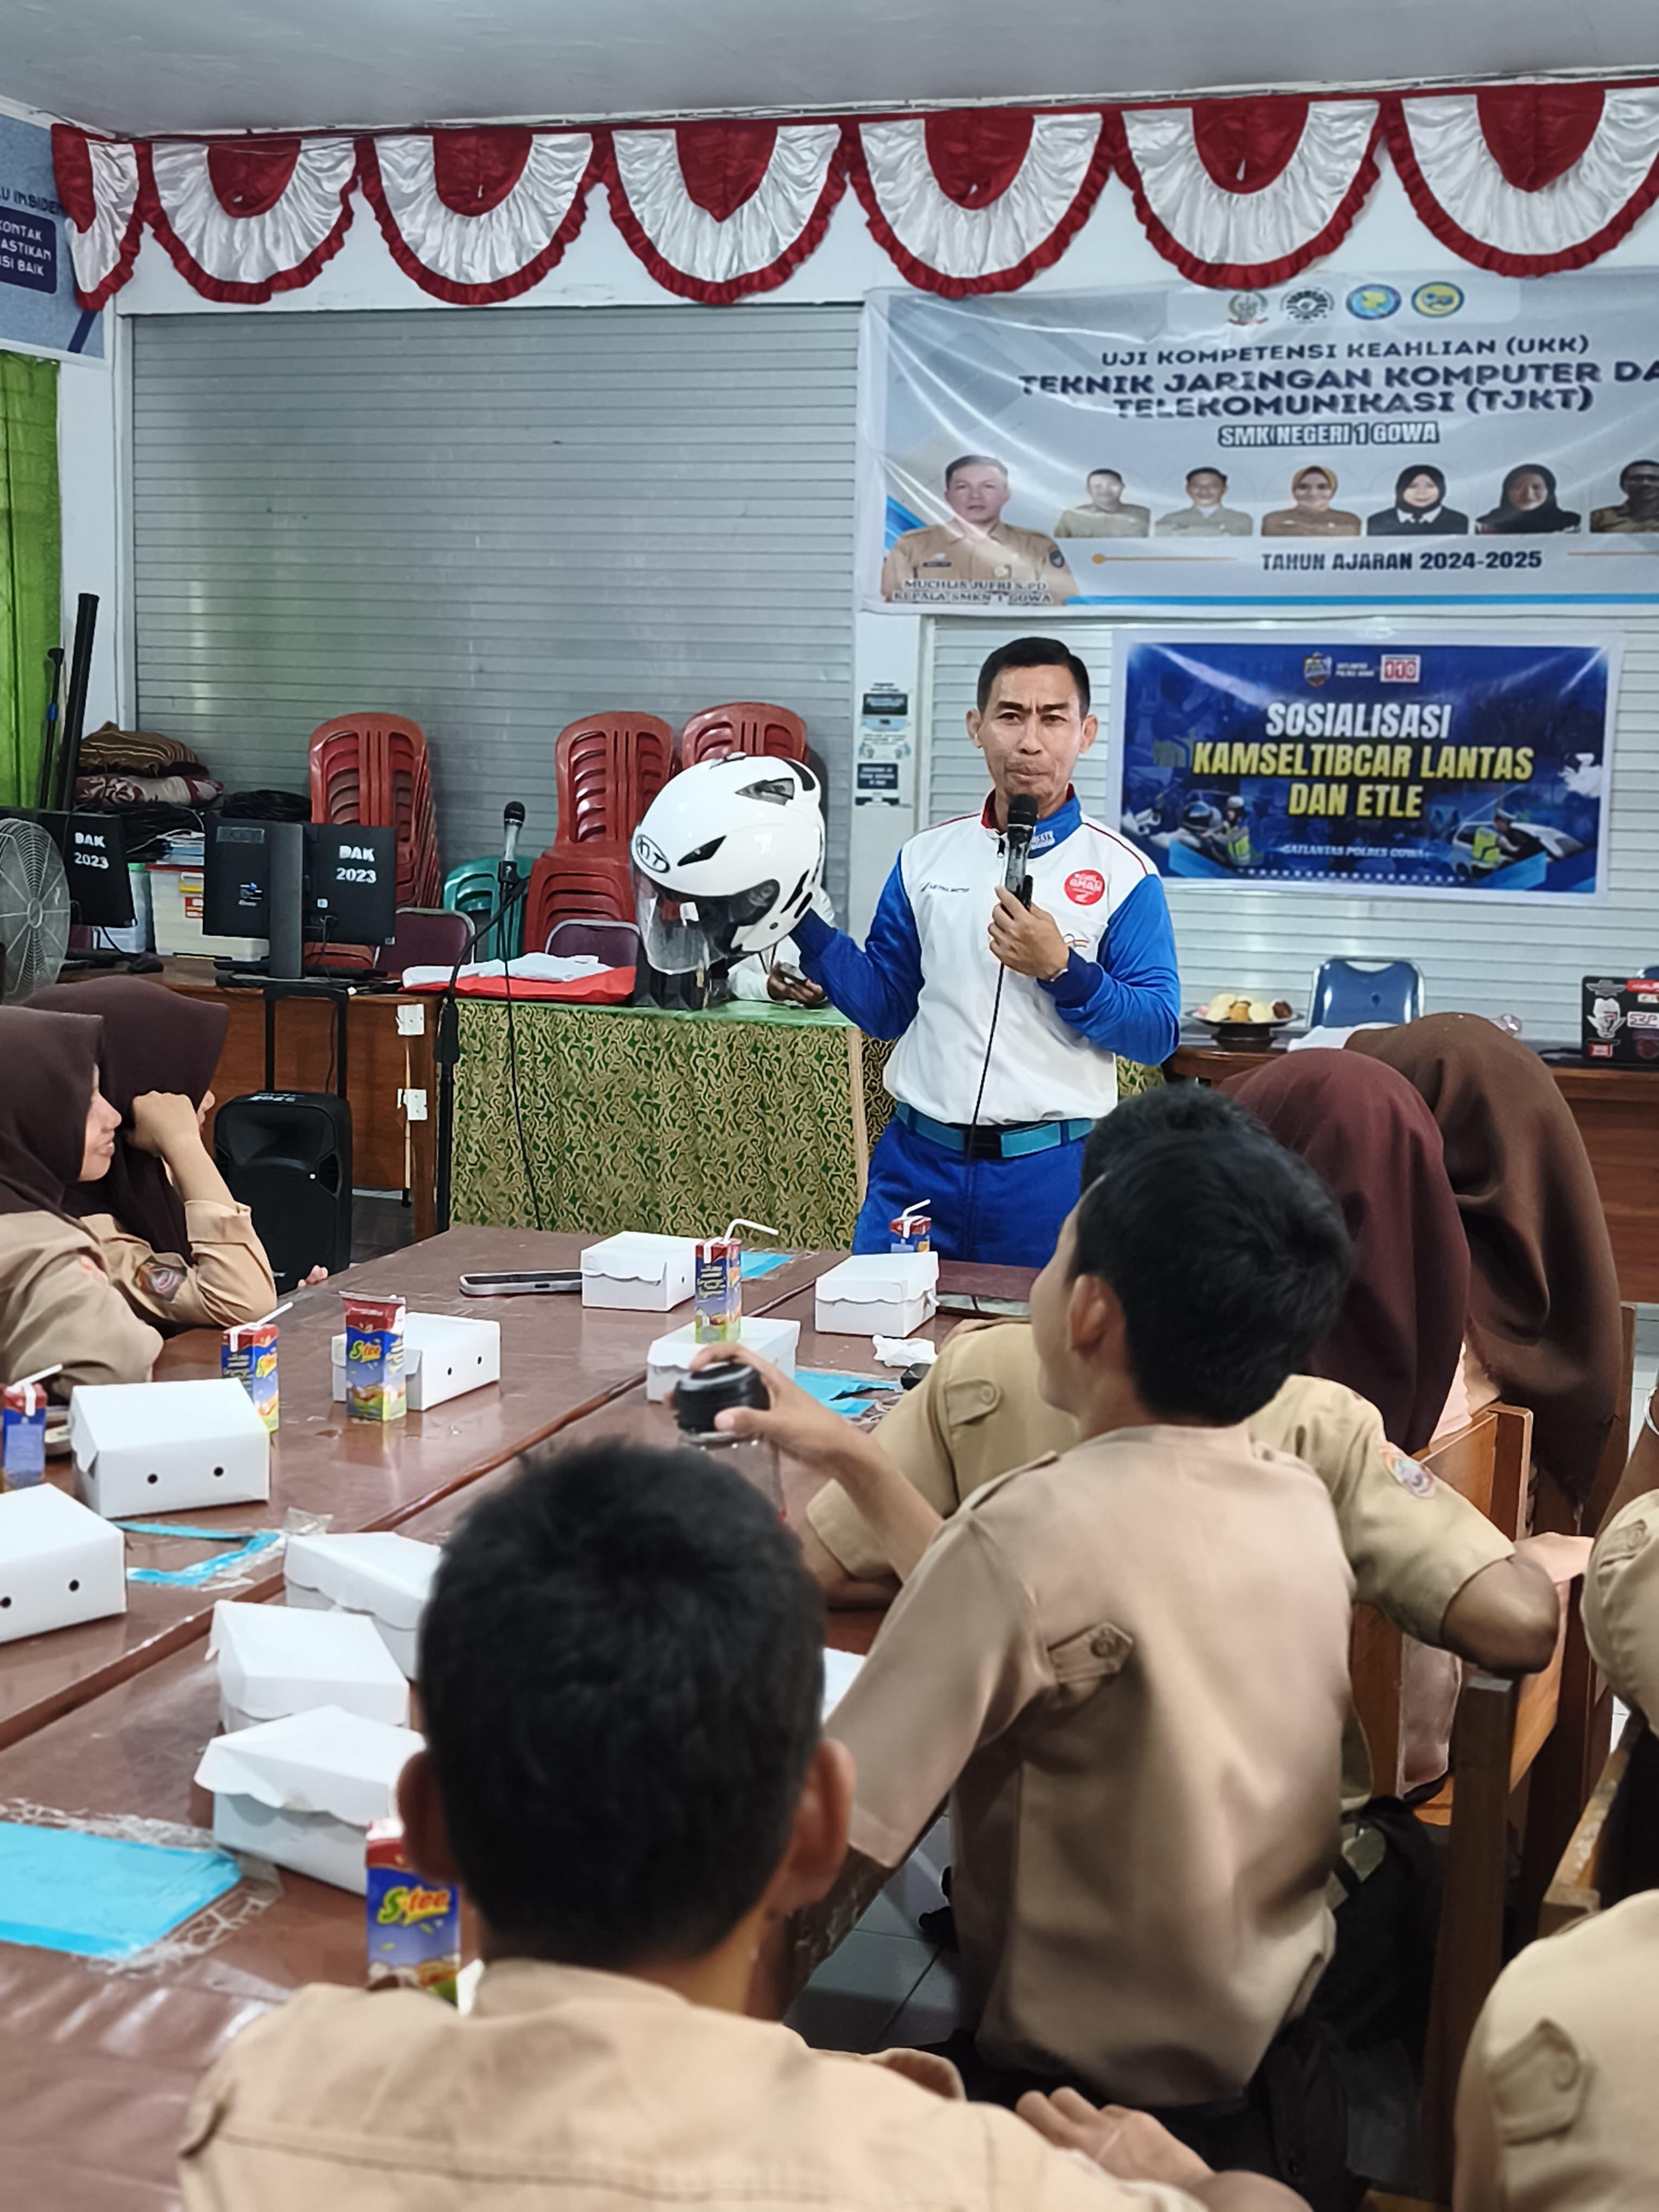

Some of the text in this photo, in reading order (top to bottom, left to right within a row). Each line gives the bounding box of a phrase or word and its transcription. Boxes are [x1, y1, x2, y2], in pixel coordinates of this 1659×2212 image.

[0, 239, 52, 261] ASTIKAN
[17, 259, 44, 276] BAIK
[1102, 334, 1589, 366] UJI KOMPETENSI KEAHLIAN (UKK)
[1018, 375, 1155, 395] TEKNIK
[1163, 365, 1372, 393] JARINGAN
[1385, 362, 1602, 388] KOMPUTER
[1113, 384, 1594, 419] TELEKOMUNIKASI (TJKT)
[1219, 422, 1439, 447] SMK NEGERI 1 GOWA
[1262, 550, 1542, 570] TAHUN AJARAN 2024-2025
[1386, 662, 1416, 678] 110
[1266, 702, 1452, 739] SOSIALISASI
[1193, 742, 1534, 781] KAMSELTIBCAR LANTAS
[1288, 783, 1424, 817] DAN ETLE
[75, 832, 106, 848] DAK
[74, 852, 109, 869] 2023
[339, 845, 375, 863] DAK
[336, 867, 377, 884] 2023
